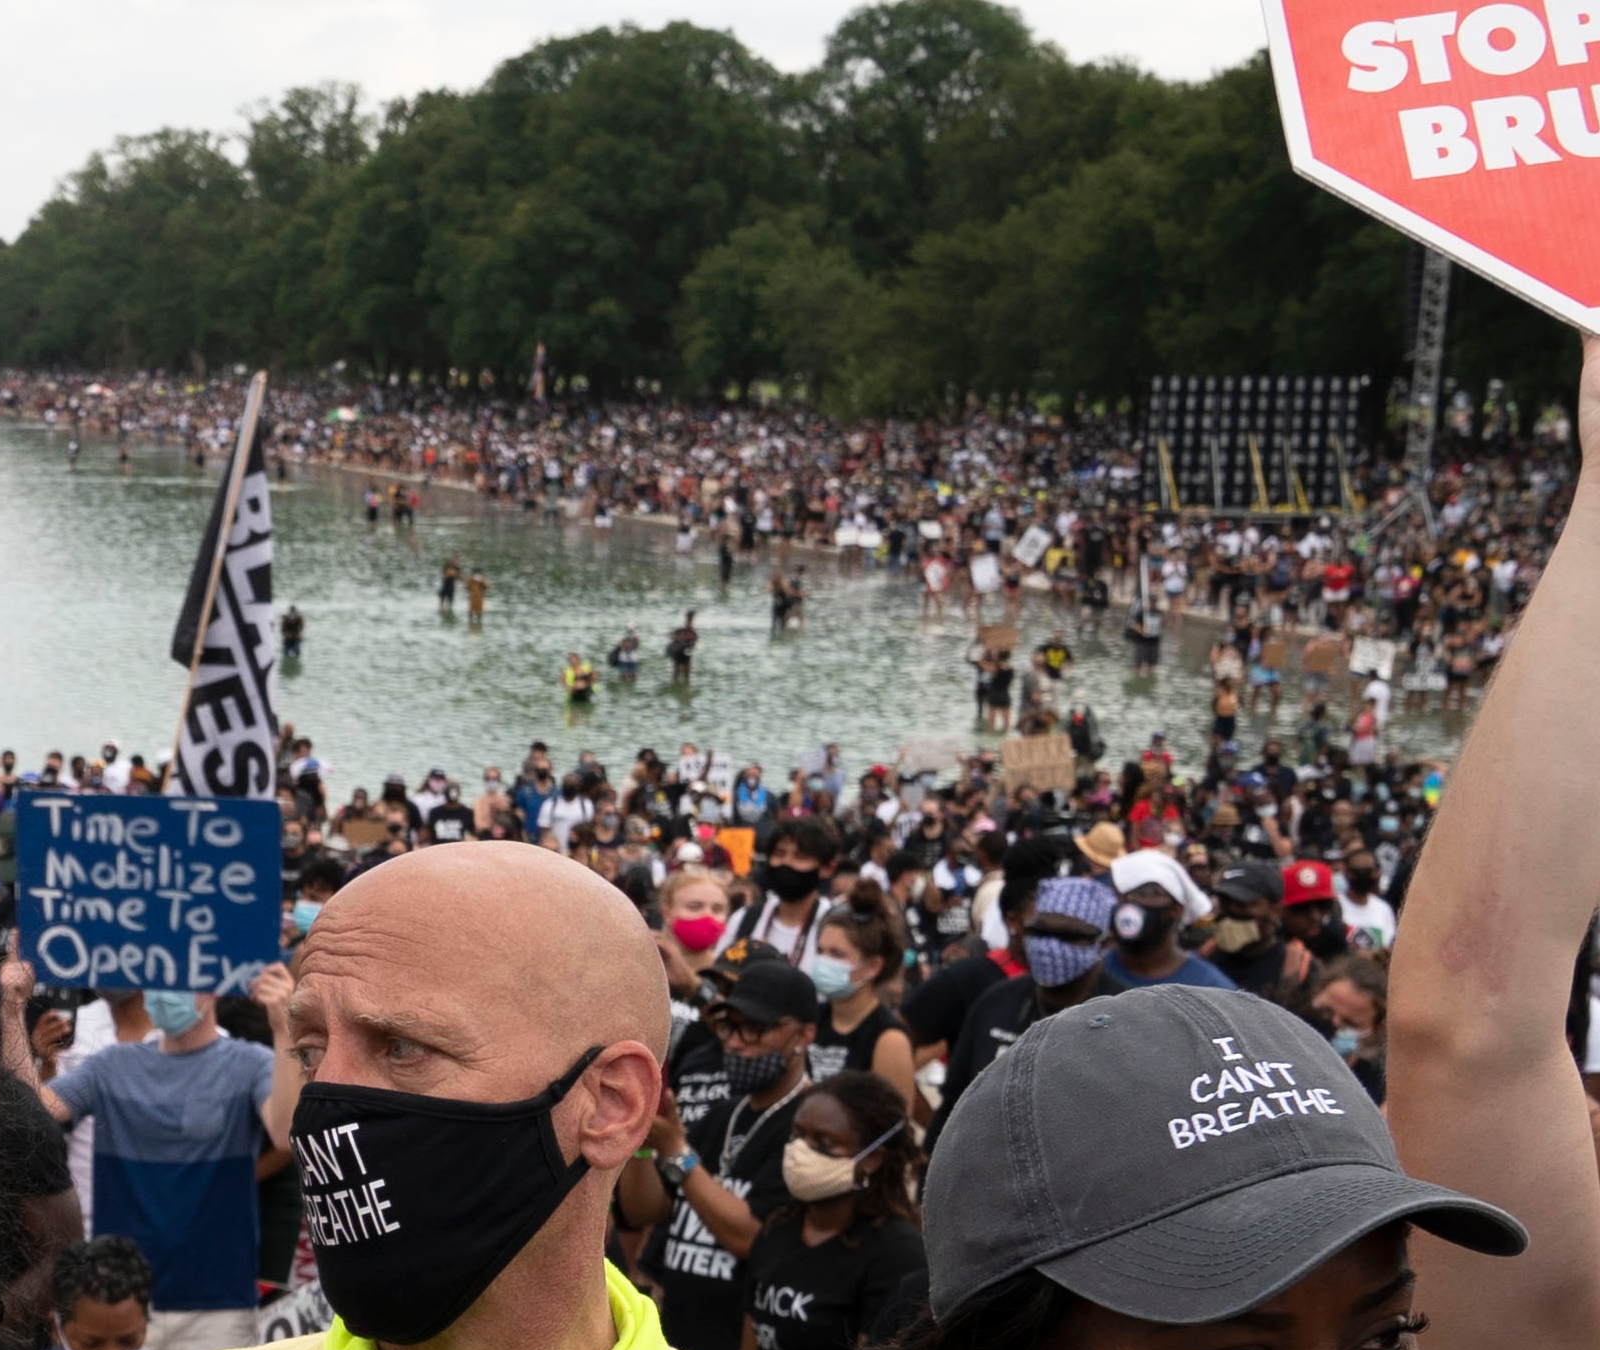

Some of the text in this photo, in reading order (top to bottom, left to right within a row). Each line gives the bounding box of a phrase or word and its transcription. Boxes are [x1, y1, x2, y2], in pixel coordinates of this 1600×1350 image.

[1341, 0, 1600, 93] STOP
[31, 798, 244, 854] Time To
[45, 844, 258, 904] Mobilize
[29, 887, 215, 932] Time To
[37, 925, 178, 988] Open
[1212, 1036, 1244, 1061] I
[1190, 1062, 1297, 1103] CAN'T
[1168, 1088, 1346, 1149] BREATHE
[291, 1122, 367, 1187] AN'T
[302, 1178, 401, 1247] REATHE
